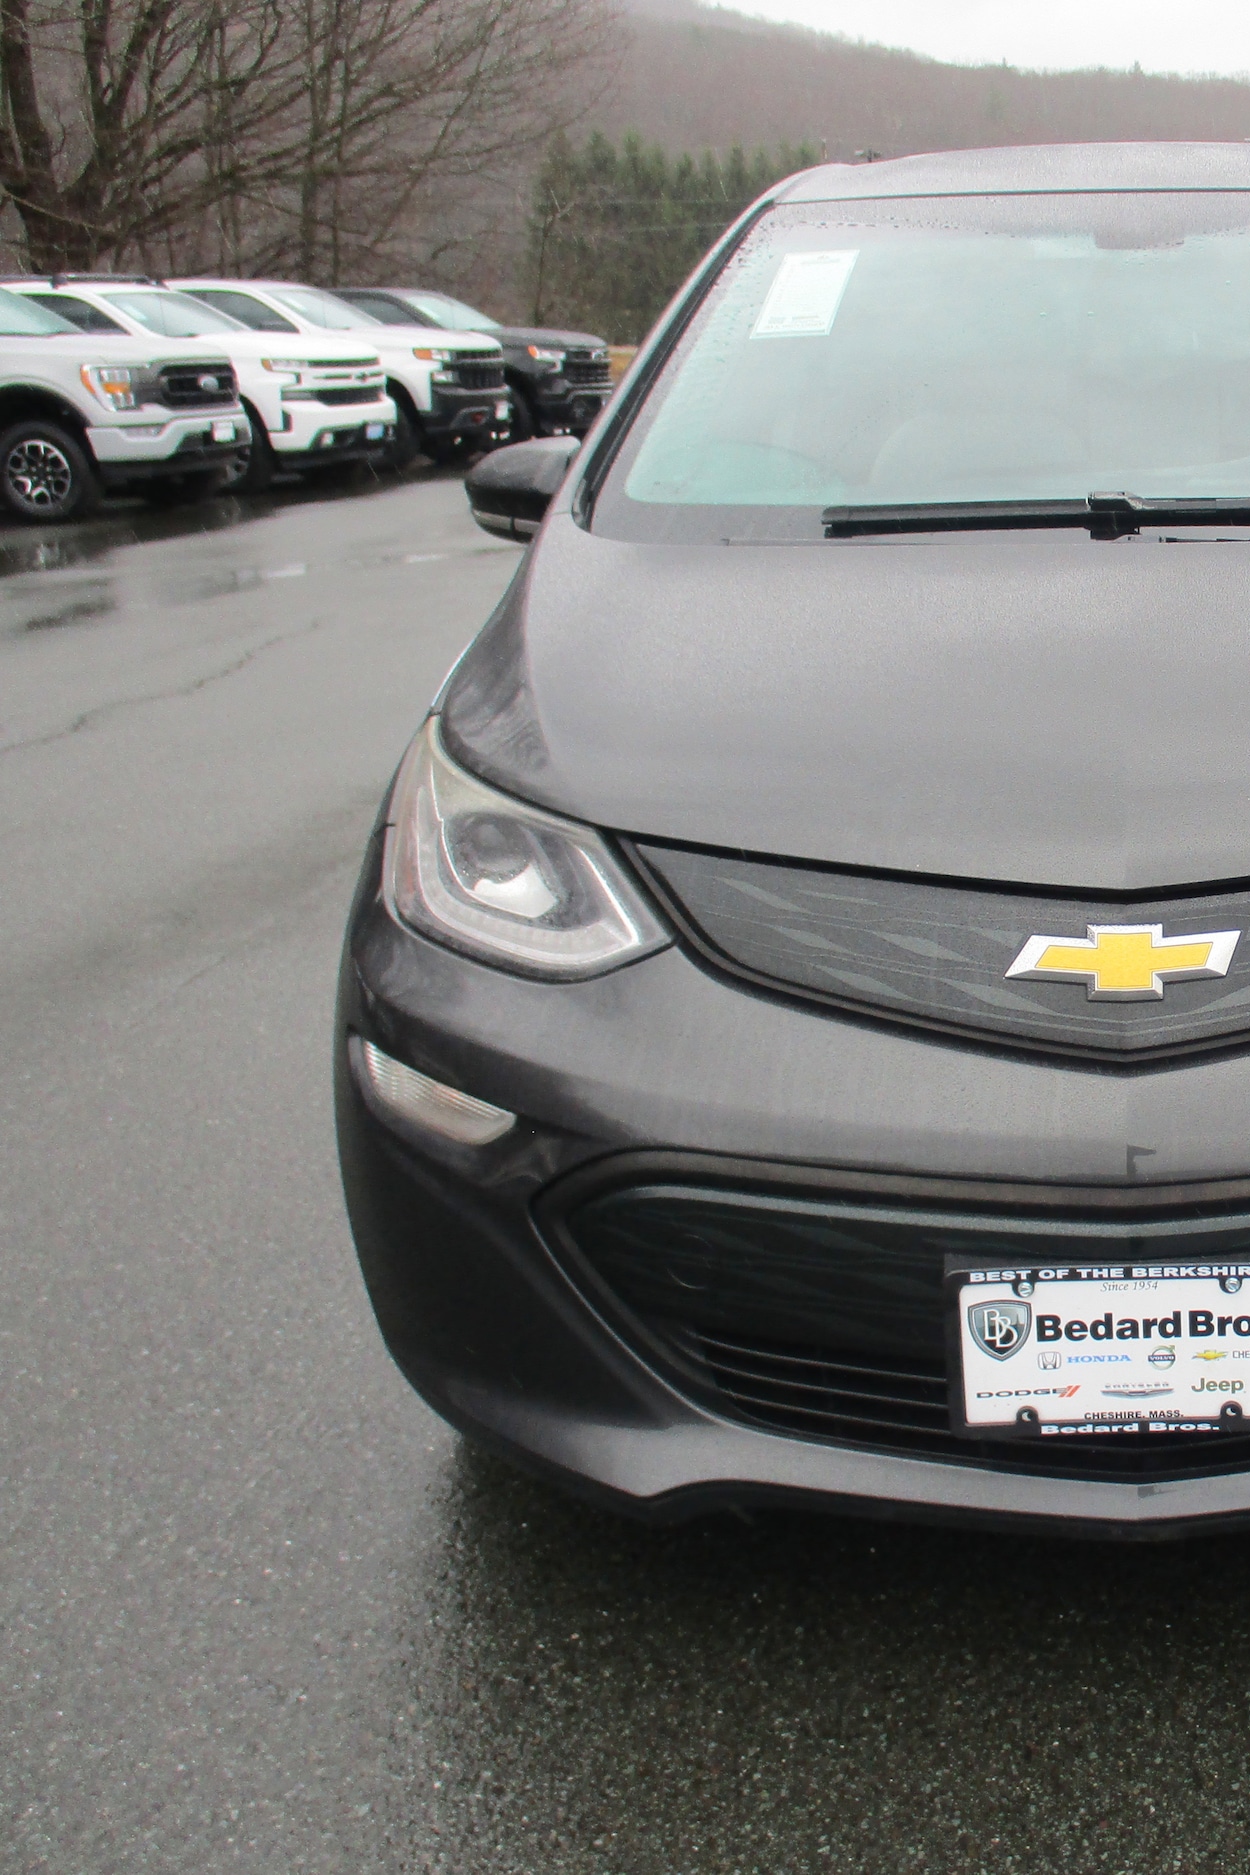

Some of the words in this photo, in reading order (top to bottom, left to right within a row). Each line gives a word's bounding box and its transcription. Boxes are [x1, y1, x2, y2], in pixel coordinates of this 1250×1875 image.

[969, 1270, 1031, 1282] BEST
[1038, 1269, 1069, 1279] OF
[1076, 1268, 1124, 1278] THE
[1100, 1281, 1129, 1292] Since
[1132, 1280, 1158, 1291] 1954
[1036, 1312, 1182, 1342] Bedard
[1067, 1354, 1132, 1364] HONDA
[1191, 1378, 1244, 1393] Jeep
[976, 1387, 1069, 1398] DODGE
[1149, 1410, 1184, 1418] MASS.
[1041, 1423, 1139, 1434] Bedard
[1149, 1422, 1220, 1432] Bros.
